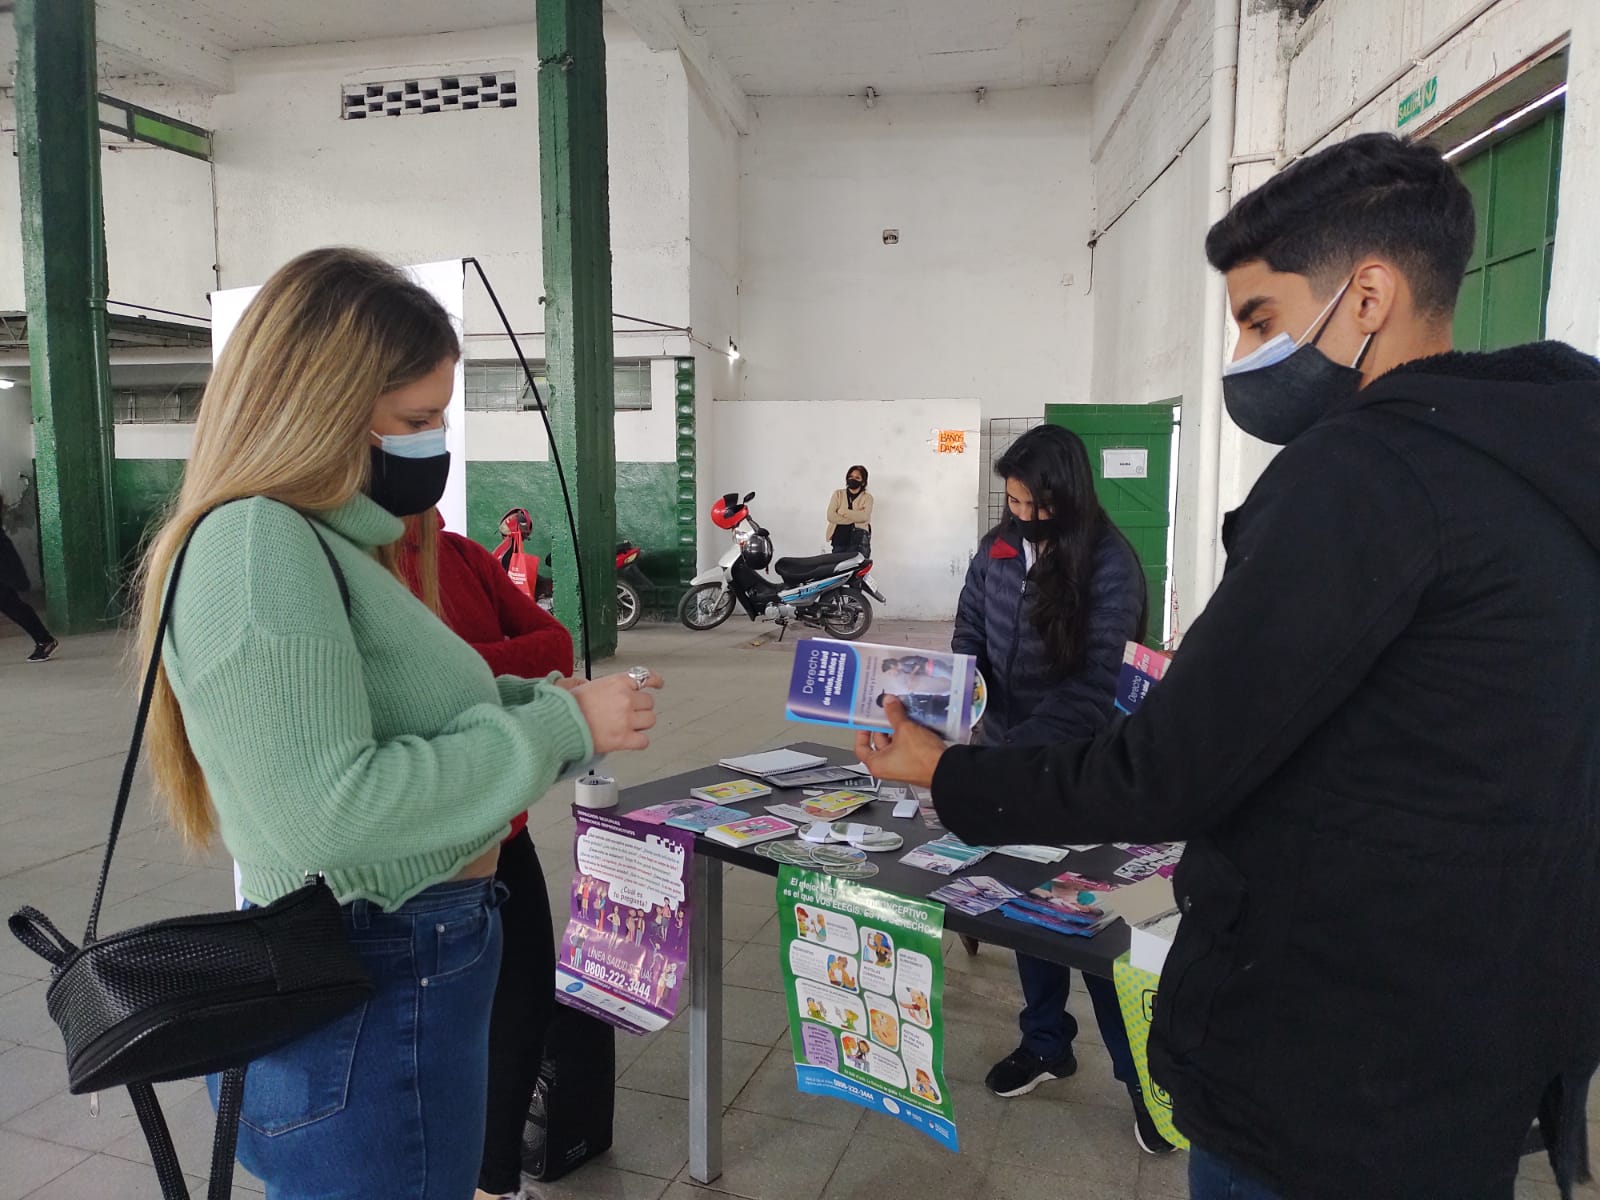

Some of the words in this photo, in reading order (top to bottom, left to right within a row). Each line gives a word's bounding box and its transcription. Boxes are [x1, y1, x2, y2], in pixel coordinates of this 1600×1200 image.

[940, 443, 964, 454] DAMAS
[820, 650, 829, 669] salud
[802, 649, 819, 694] Derecho
[833, 653, 847, 695] adolescentes
[1127, 675, 1142, 703] Derecho
[822, 696, 831, 706] de
[790, 877, 798, 886] El
[801, 893, 814, 904] que
[584, 959, 651, 1000] 0800-222-3444
